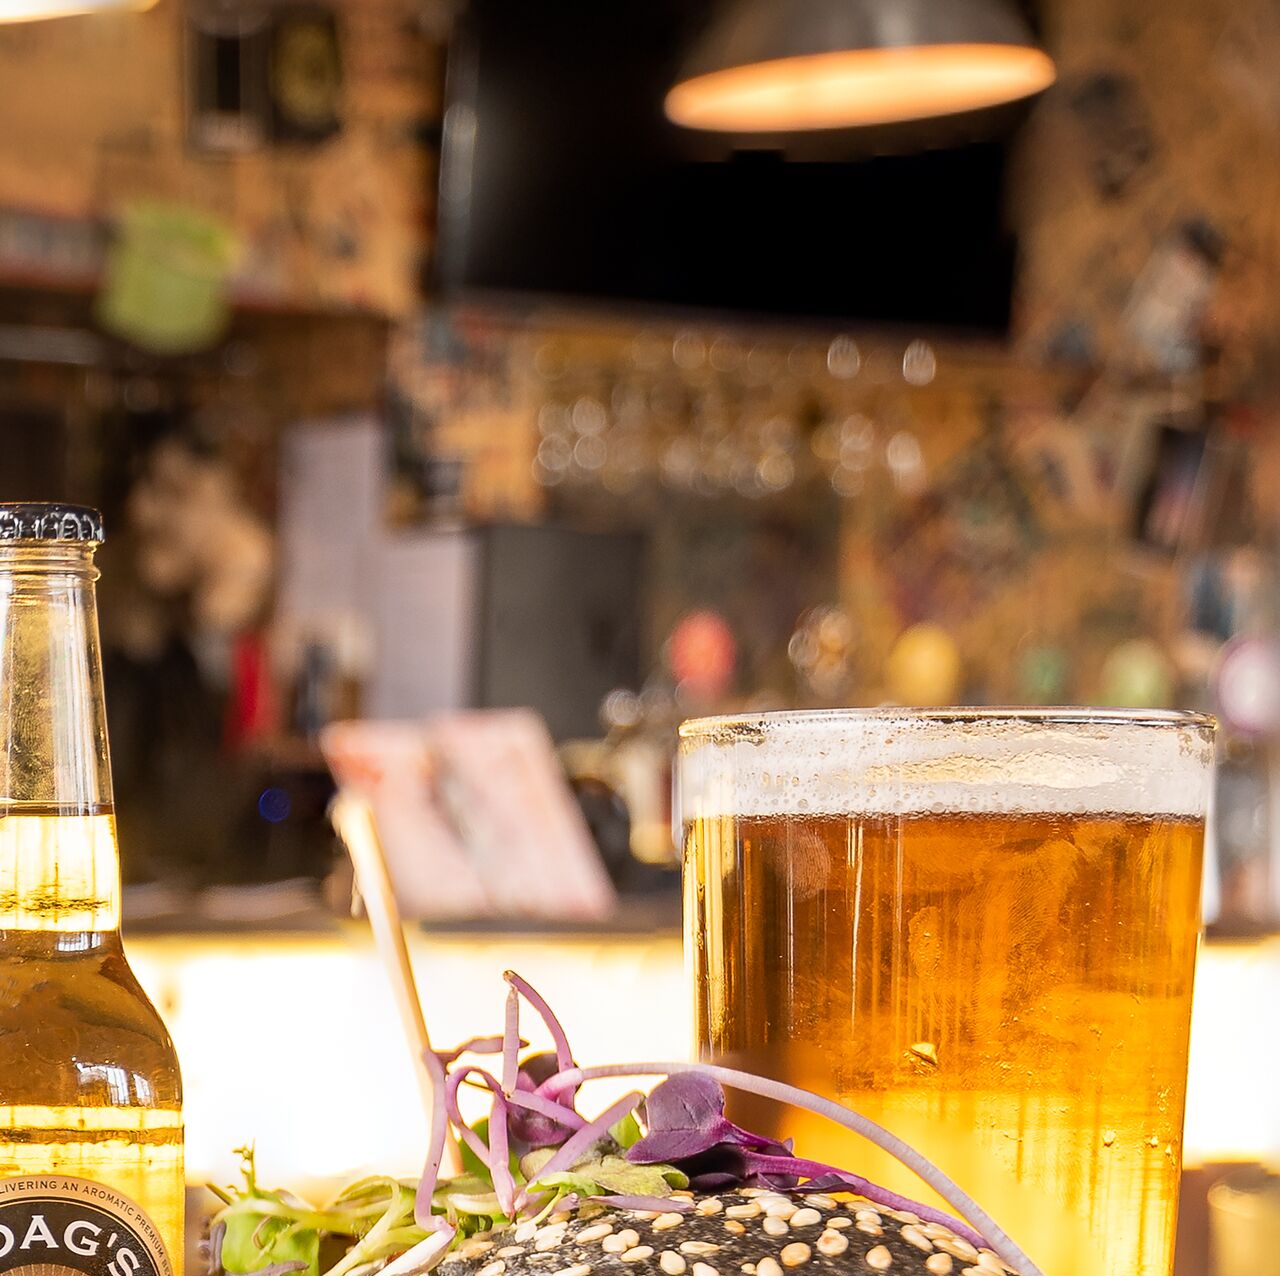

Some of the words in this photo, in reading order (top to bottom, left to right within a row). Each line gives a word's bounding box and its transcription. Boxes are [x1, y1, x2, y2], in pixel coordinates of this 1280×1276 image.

[61, 1182, 79, 1192] AN
[82, 1186, 134, 1216] AROMATIC
[134, 1214, 164, 1258] PREMIUM
